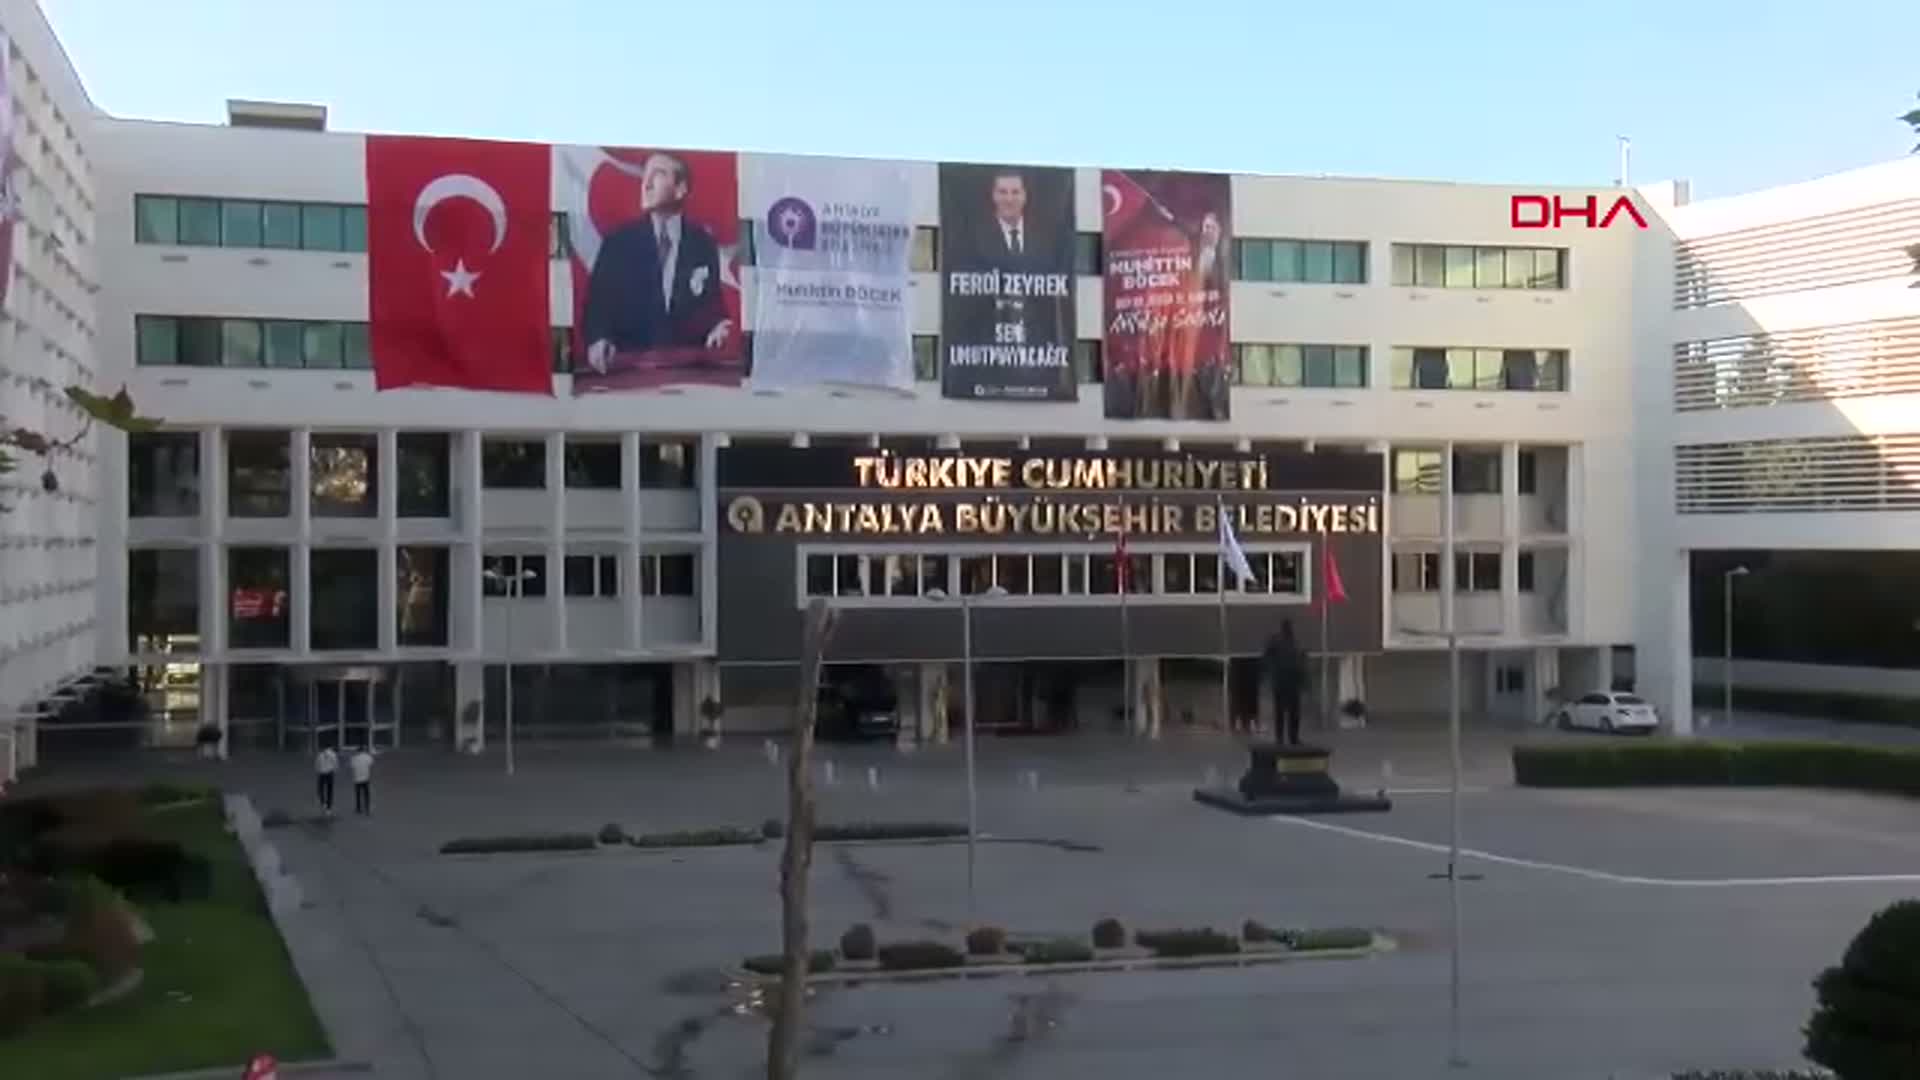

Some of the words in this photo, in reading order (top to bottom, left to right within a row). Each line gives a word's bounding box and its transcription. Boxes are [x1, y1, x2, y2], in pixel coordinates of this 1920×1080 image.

[950, 268, 999, 295] FERDİ
[1002, 273, 1069, 297] ZEYREK
[854, 449, 1011, 488] TÜRKİYE
[1022, 453, 1268, 490] CUMHURİYETİ
[776, 502, 943, 533] ANTALYA
[955, 496, 1182, 540] BÜYÜKŞEHİR
